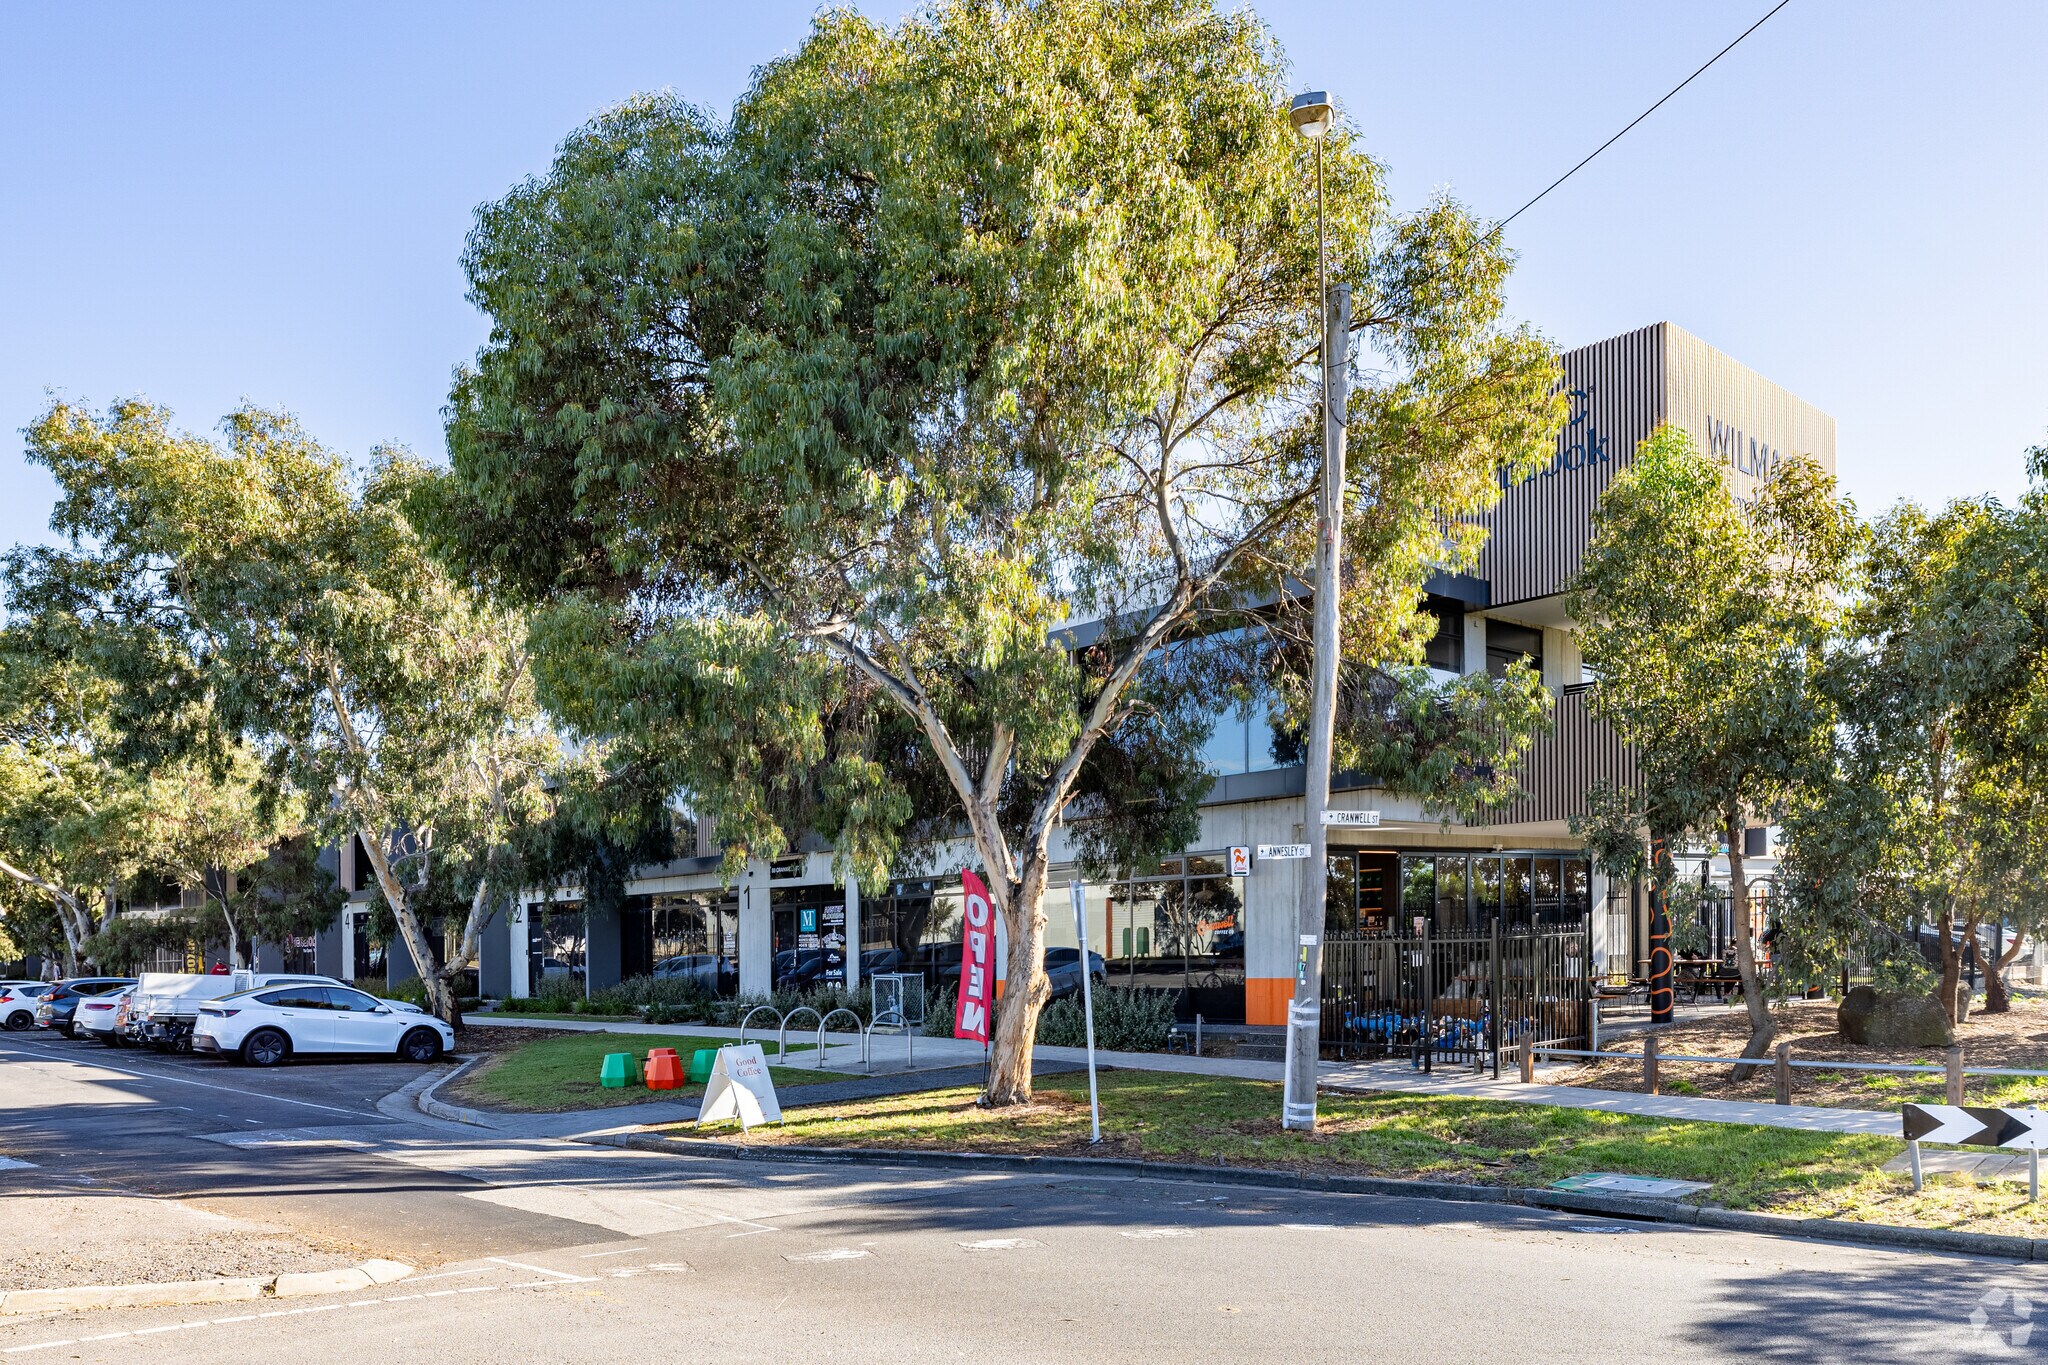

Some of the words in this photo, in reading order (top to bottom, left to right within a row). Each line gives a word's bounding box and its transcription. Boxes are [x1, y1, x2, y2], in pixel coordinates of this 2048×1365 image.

[1707, 414, 1796, 483] WILMA
[1337, 812, 1371, 824] CRANWELL
[1372, 815, 1379, 824] ST
[1268, 846, 1299, 857] ANNESLEY
[1299, 848, 1306, 857] ST
[743, 885, 750, 910] 1
[515, 903, 523, 923] 2
[344, 913, 351, 930] 4
[736, 1056, 757, 1067] Good
[737, 1067, 762, 1077] Coffee
